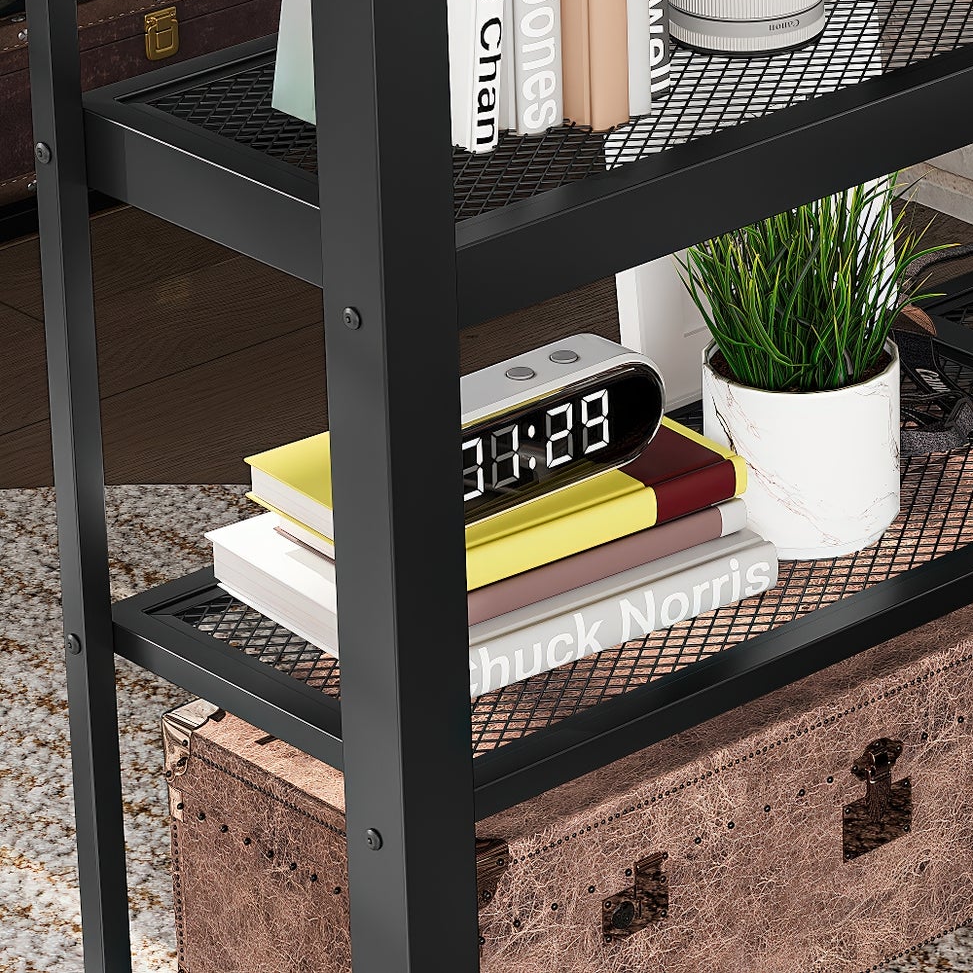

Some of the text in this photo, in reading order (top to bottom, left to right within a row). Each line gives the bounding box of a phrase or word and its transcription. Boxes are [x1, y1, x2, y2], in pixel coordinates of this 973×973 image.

[768, 19, 800, 31] Canon
[476, 15, 504, 145] Chan
[619, 557, 770, 643] Norris
